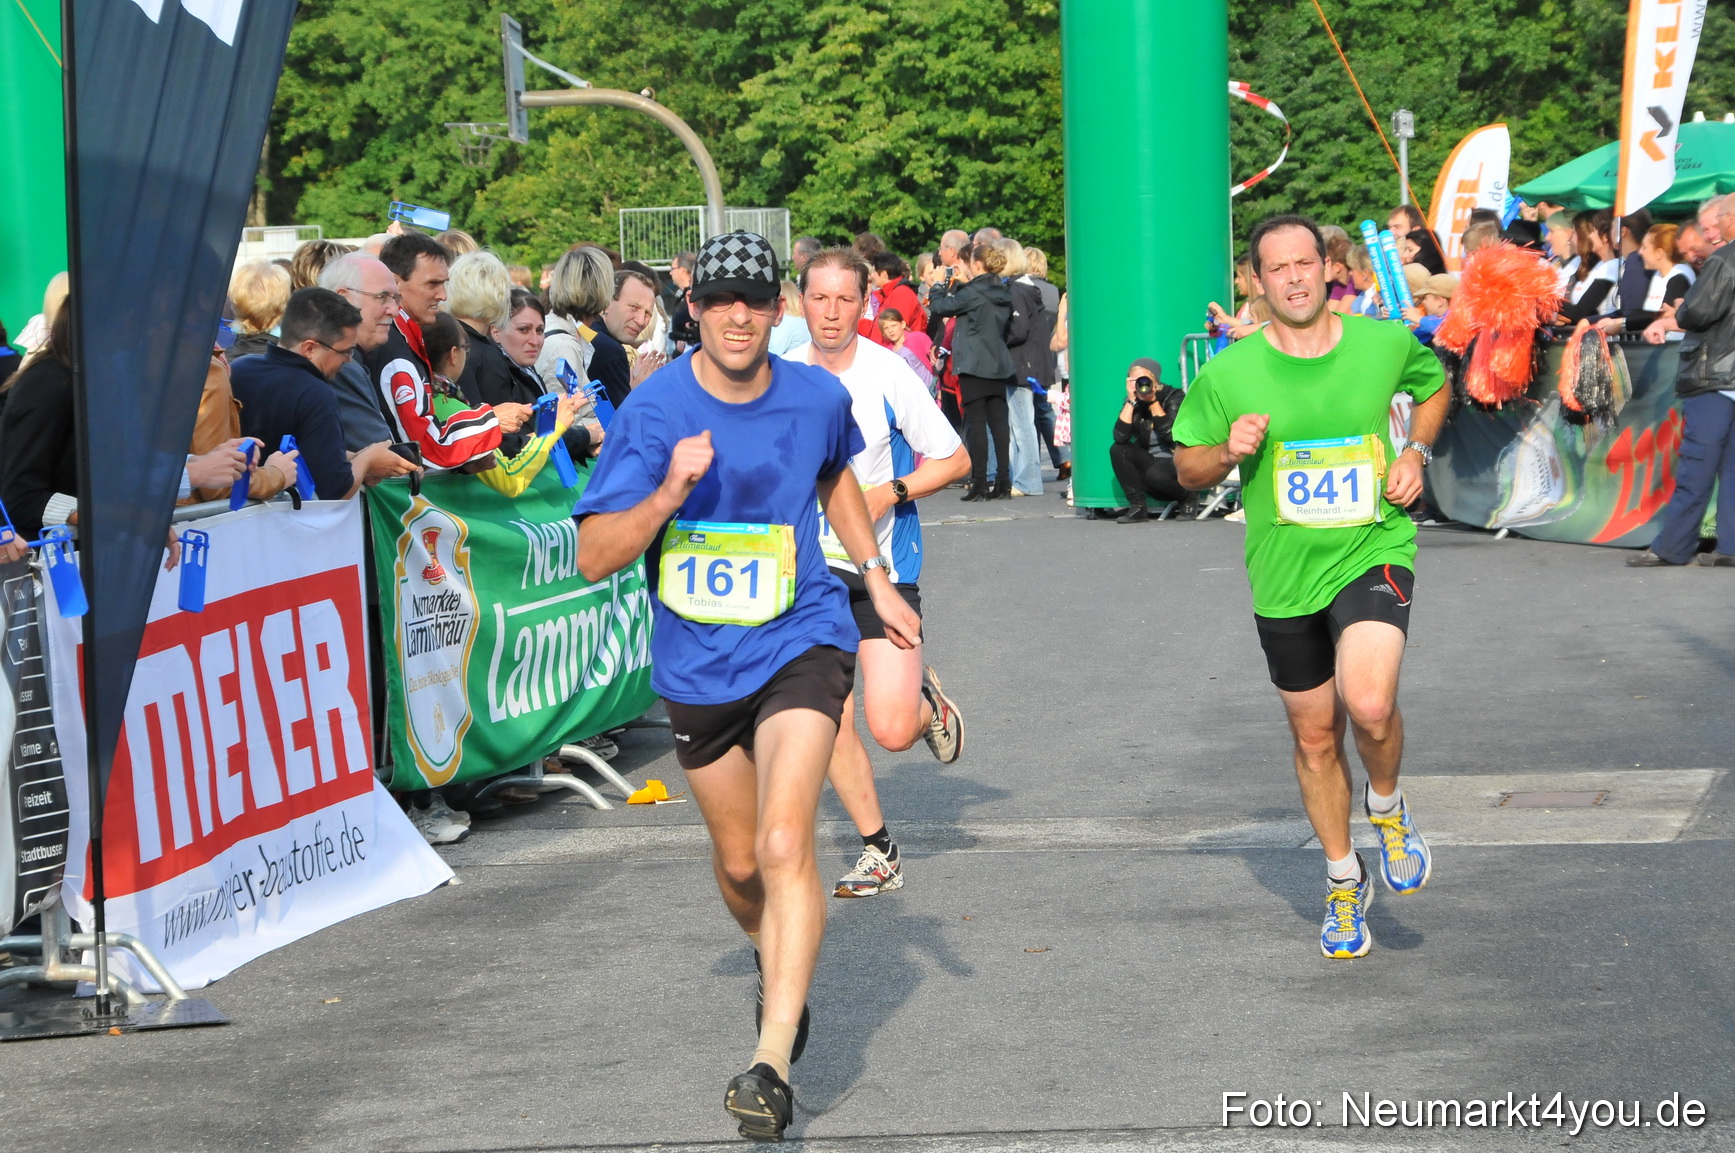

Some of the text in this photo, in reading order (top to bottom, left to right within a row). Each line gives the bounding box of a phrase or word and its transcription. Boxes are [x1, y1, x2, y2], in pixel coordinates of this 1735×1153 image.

[1287, 468, 1358, 505] 841
[1296, 506, 1341, 515] Reinhardt
[679, 541, 721, 551] firmenlauf
[677, 556, 759, 599] 161
[687, 596, 723, 608] Tobias
[124, 598, 369, 863] MEIER
